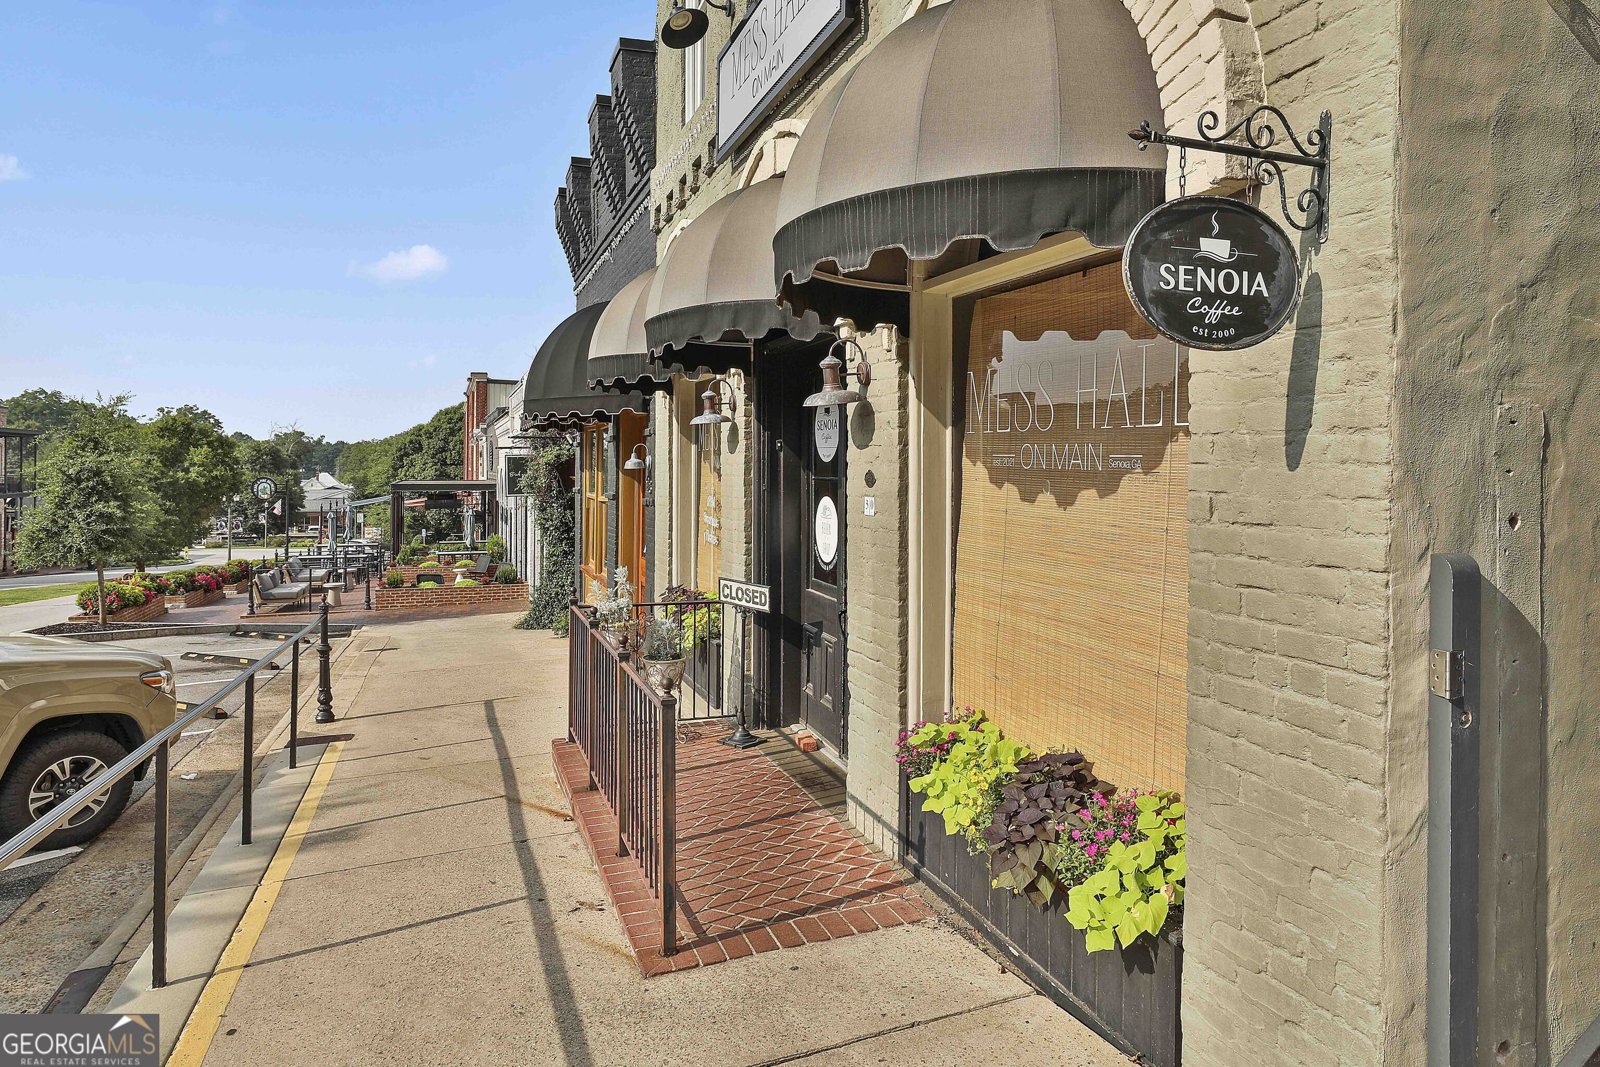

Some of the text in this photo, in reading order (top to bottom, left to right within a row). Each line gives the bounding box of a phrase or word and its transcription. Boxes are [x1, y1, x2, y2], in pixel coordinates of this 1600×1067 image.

[731, 5, 768, 99] MESS
[752, 43, 784, 98] ON MAIN
[1159, 263, 1269, 297] SENOIA
[1186, 297, 1243, 324] Coffee
[1192, 325, 1235, 338] est 2000
[966, 359, 1054, 434] MESS
[816, 419, 838, 431] SENOIA
[1020, 443, 1046, 470] ON
[1051, 443, 1102, 471] MAIN
[722, 583, 767, 607] CLOSED
